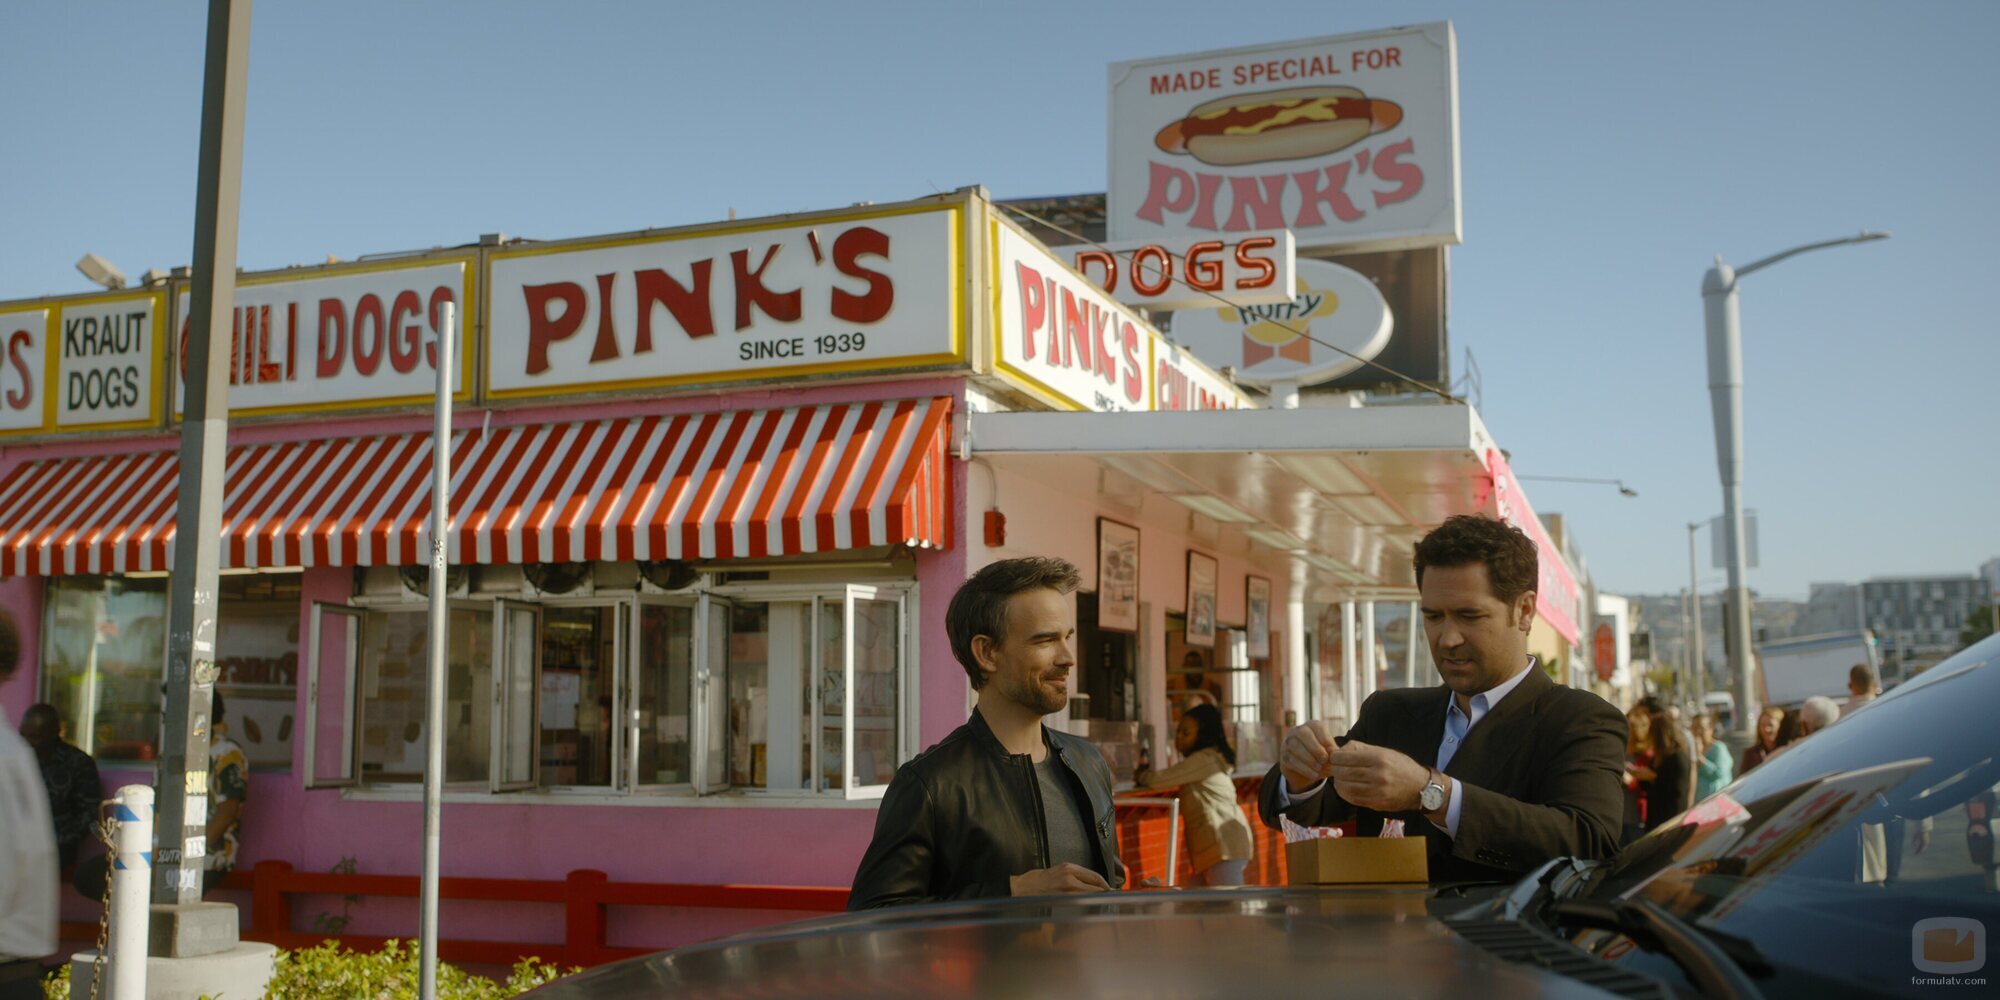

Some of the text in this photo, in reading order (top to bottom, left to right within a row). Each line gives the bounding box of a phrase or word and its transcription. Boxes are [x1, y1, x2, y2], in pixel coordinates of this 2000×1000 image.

[1150, 46, 1402, 95] MADE SPECIAL FOR
[1135, 137, 1424, 232] PINK'S
[1074, 236, 1277, 297] DOGS
[521, 226, 894, 376] PINK'S
[1015, 259, 1143, 404] PINK'S
[64, 312, 147, 359] KRAUT
[181, 303, 298, 386] ILI
[740, 333, 866, 361] SINCE 1939
[67, 366, 140, 412] DOGS
